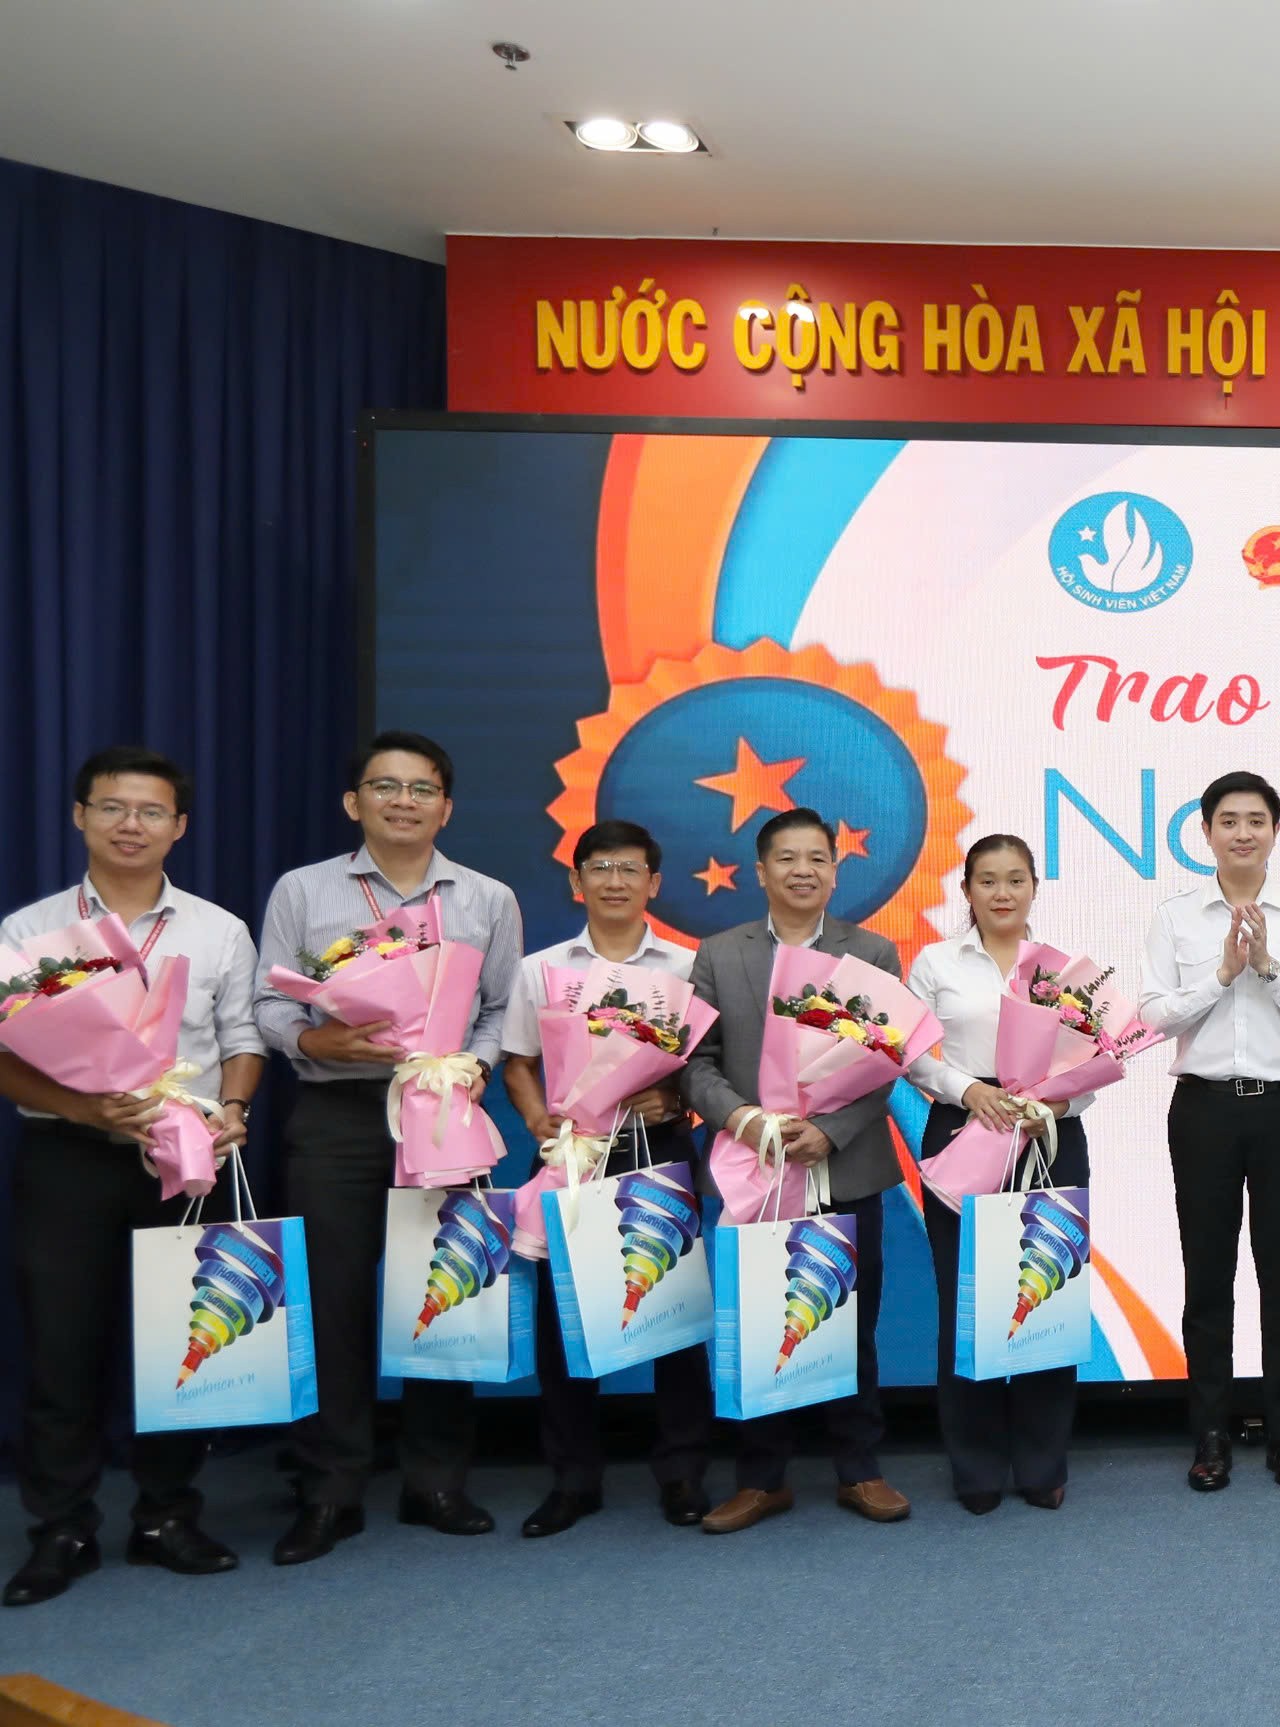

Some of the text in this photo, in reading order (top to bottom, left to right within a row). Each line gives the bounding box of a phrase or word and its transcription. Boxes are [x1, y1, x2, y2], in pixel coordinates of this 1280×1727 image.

[535, 277, 708, 371] NƯỚC
[733, 284, 901, 391] CỘNG
[923, 284, 1044, 375] HÒA
[1067, 289, 1146, 376] XÃ
[1167, 289, 1267, 393] HỘI
[1072, 585, 1103, 605] SINH
[1165, 565, 1186, 589] NAM
[1036, 654, 1271, 732] Trao
